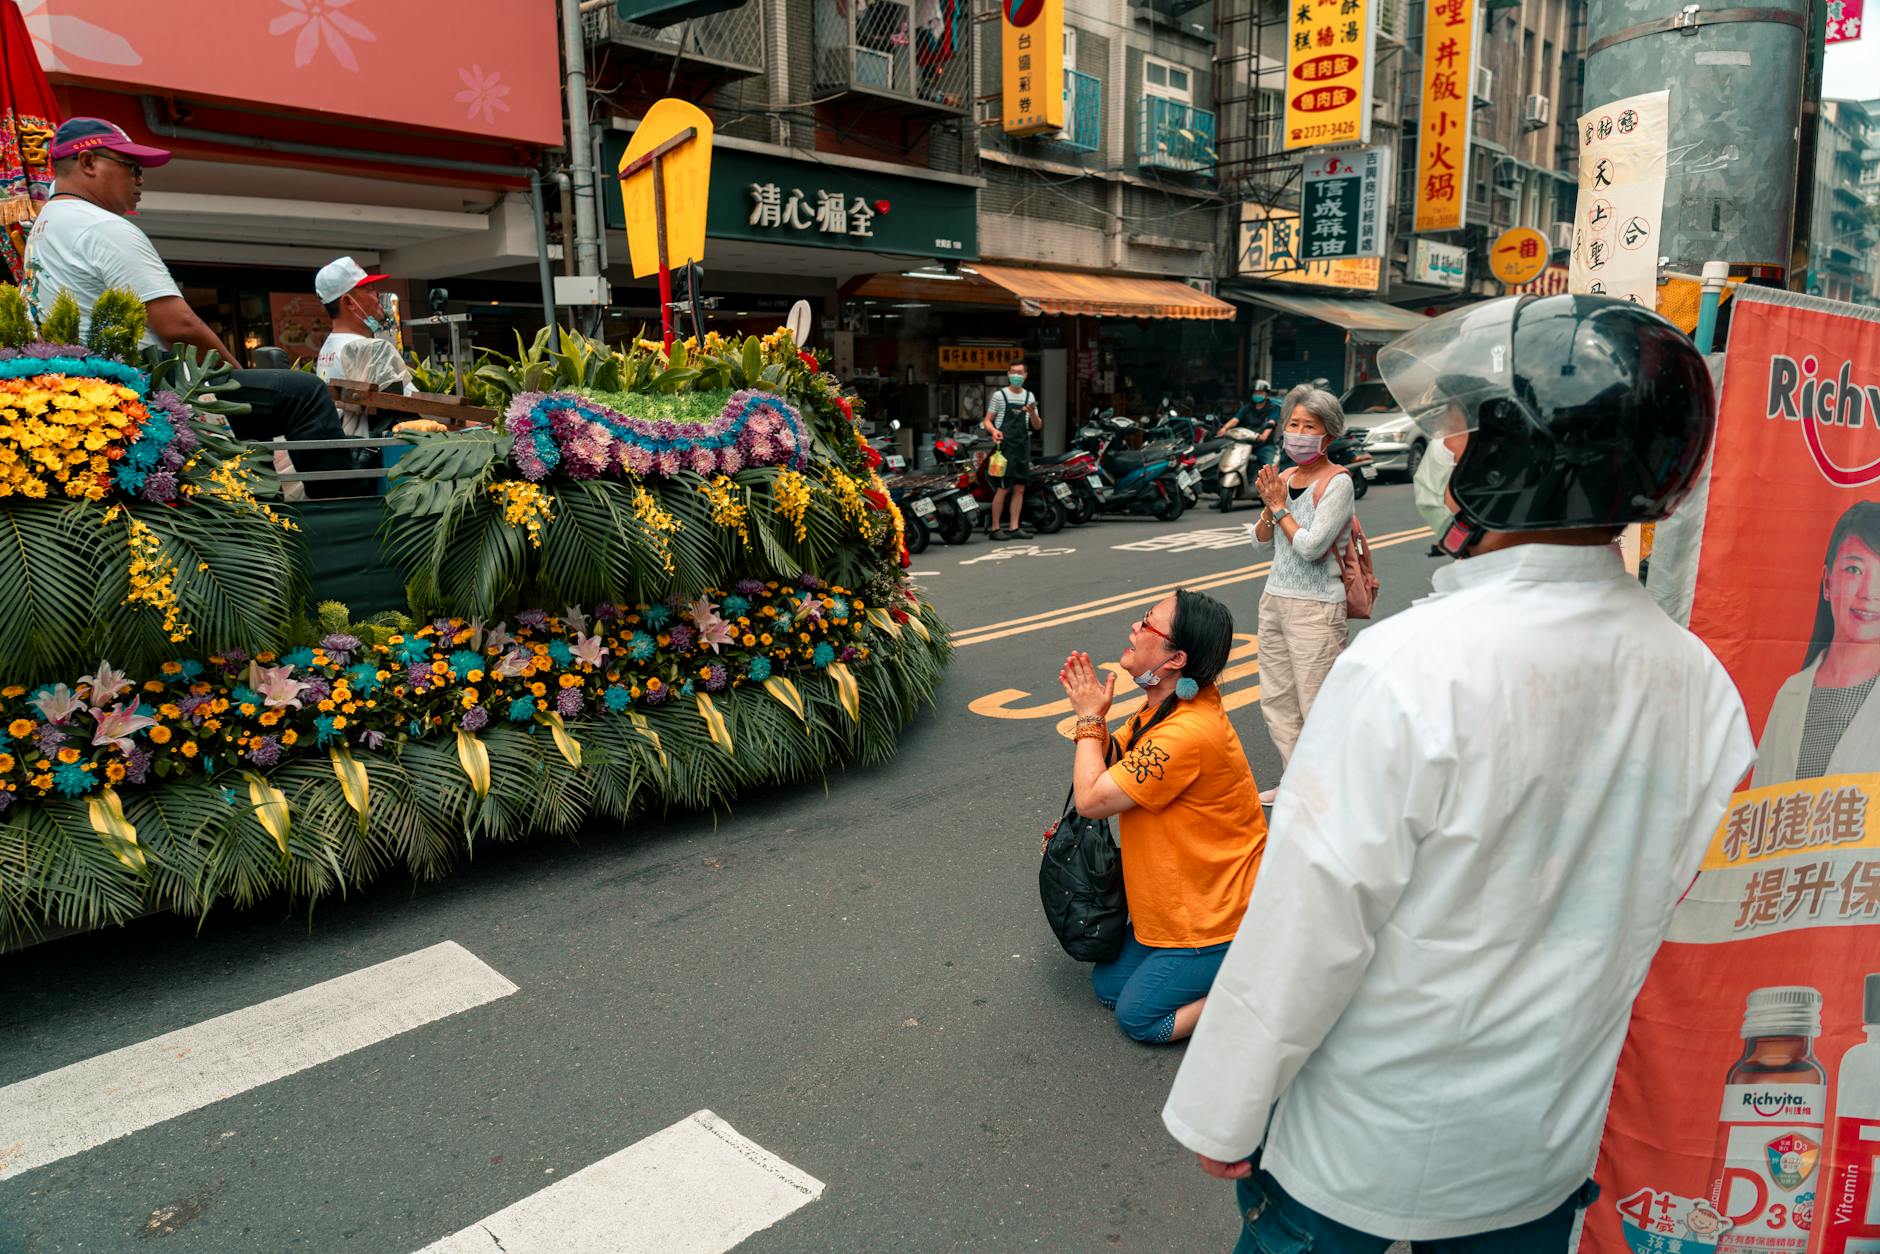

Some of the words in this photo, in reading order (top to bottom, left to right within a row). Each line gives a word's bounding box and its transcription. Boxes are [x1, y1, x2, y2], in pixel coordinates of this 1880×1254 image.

[749, 182, 875, 237] 清心福全
[1498, 238, 1538, 259] 一番
[1723, 786, 1868, 861] 利捷維
[1834, 1164, 1859, 1226] Vitamin
